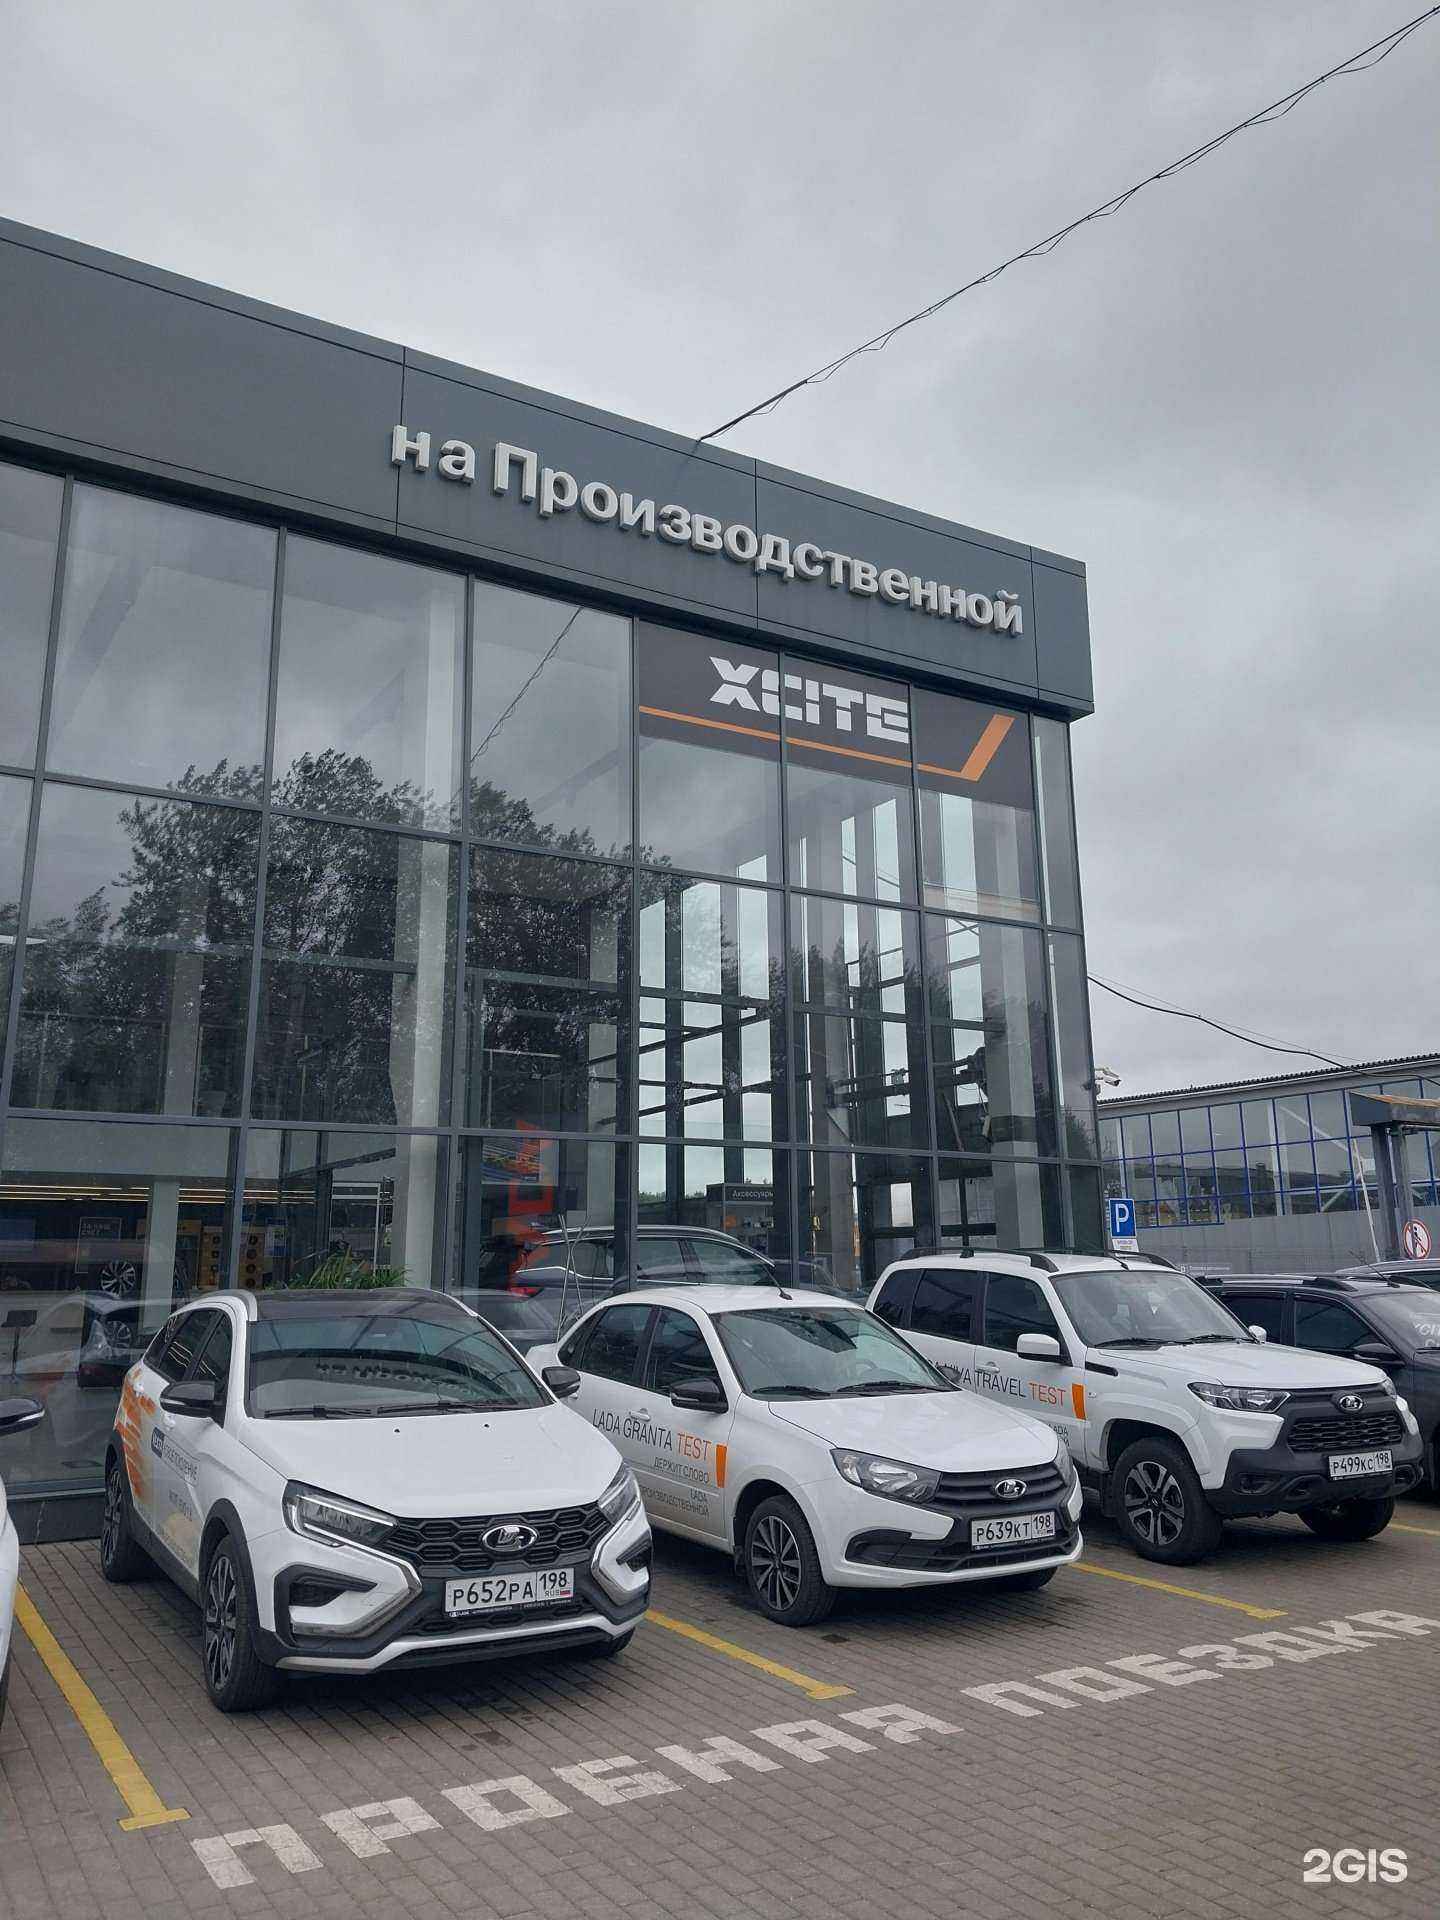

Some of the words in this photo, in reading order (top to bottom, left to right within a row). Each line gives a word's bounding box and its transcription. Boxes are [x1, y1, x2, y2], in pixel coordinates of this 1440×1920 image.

[391, 424, 476, 484] на
[493, 441, 1024, 637] Производственной
[708, 655, 909, 744] XCITE
[1115, 1203, 1130, 1233] P
[975, 1369, 1027, 1398] TRAVEL
[1028, 1382, 1066, 1407] TEST
[592, 1408, 621, 1435] LADA
[623, 1418, 673, 1452] GRANTA
[677, 1432, 712, 1461] TEST
[1032, 1514, 1051, 1530] 198
[539, 1571, 567, 1591] 198
[959, 1609, 1440, 1717] ПОЕЗДКА
[190, 1702, 965, 1889] ПРОБНАЯ
